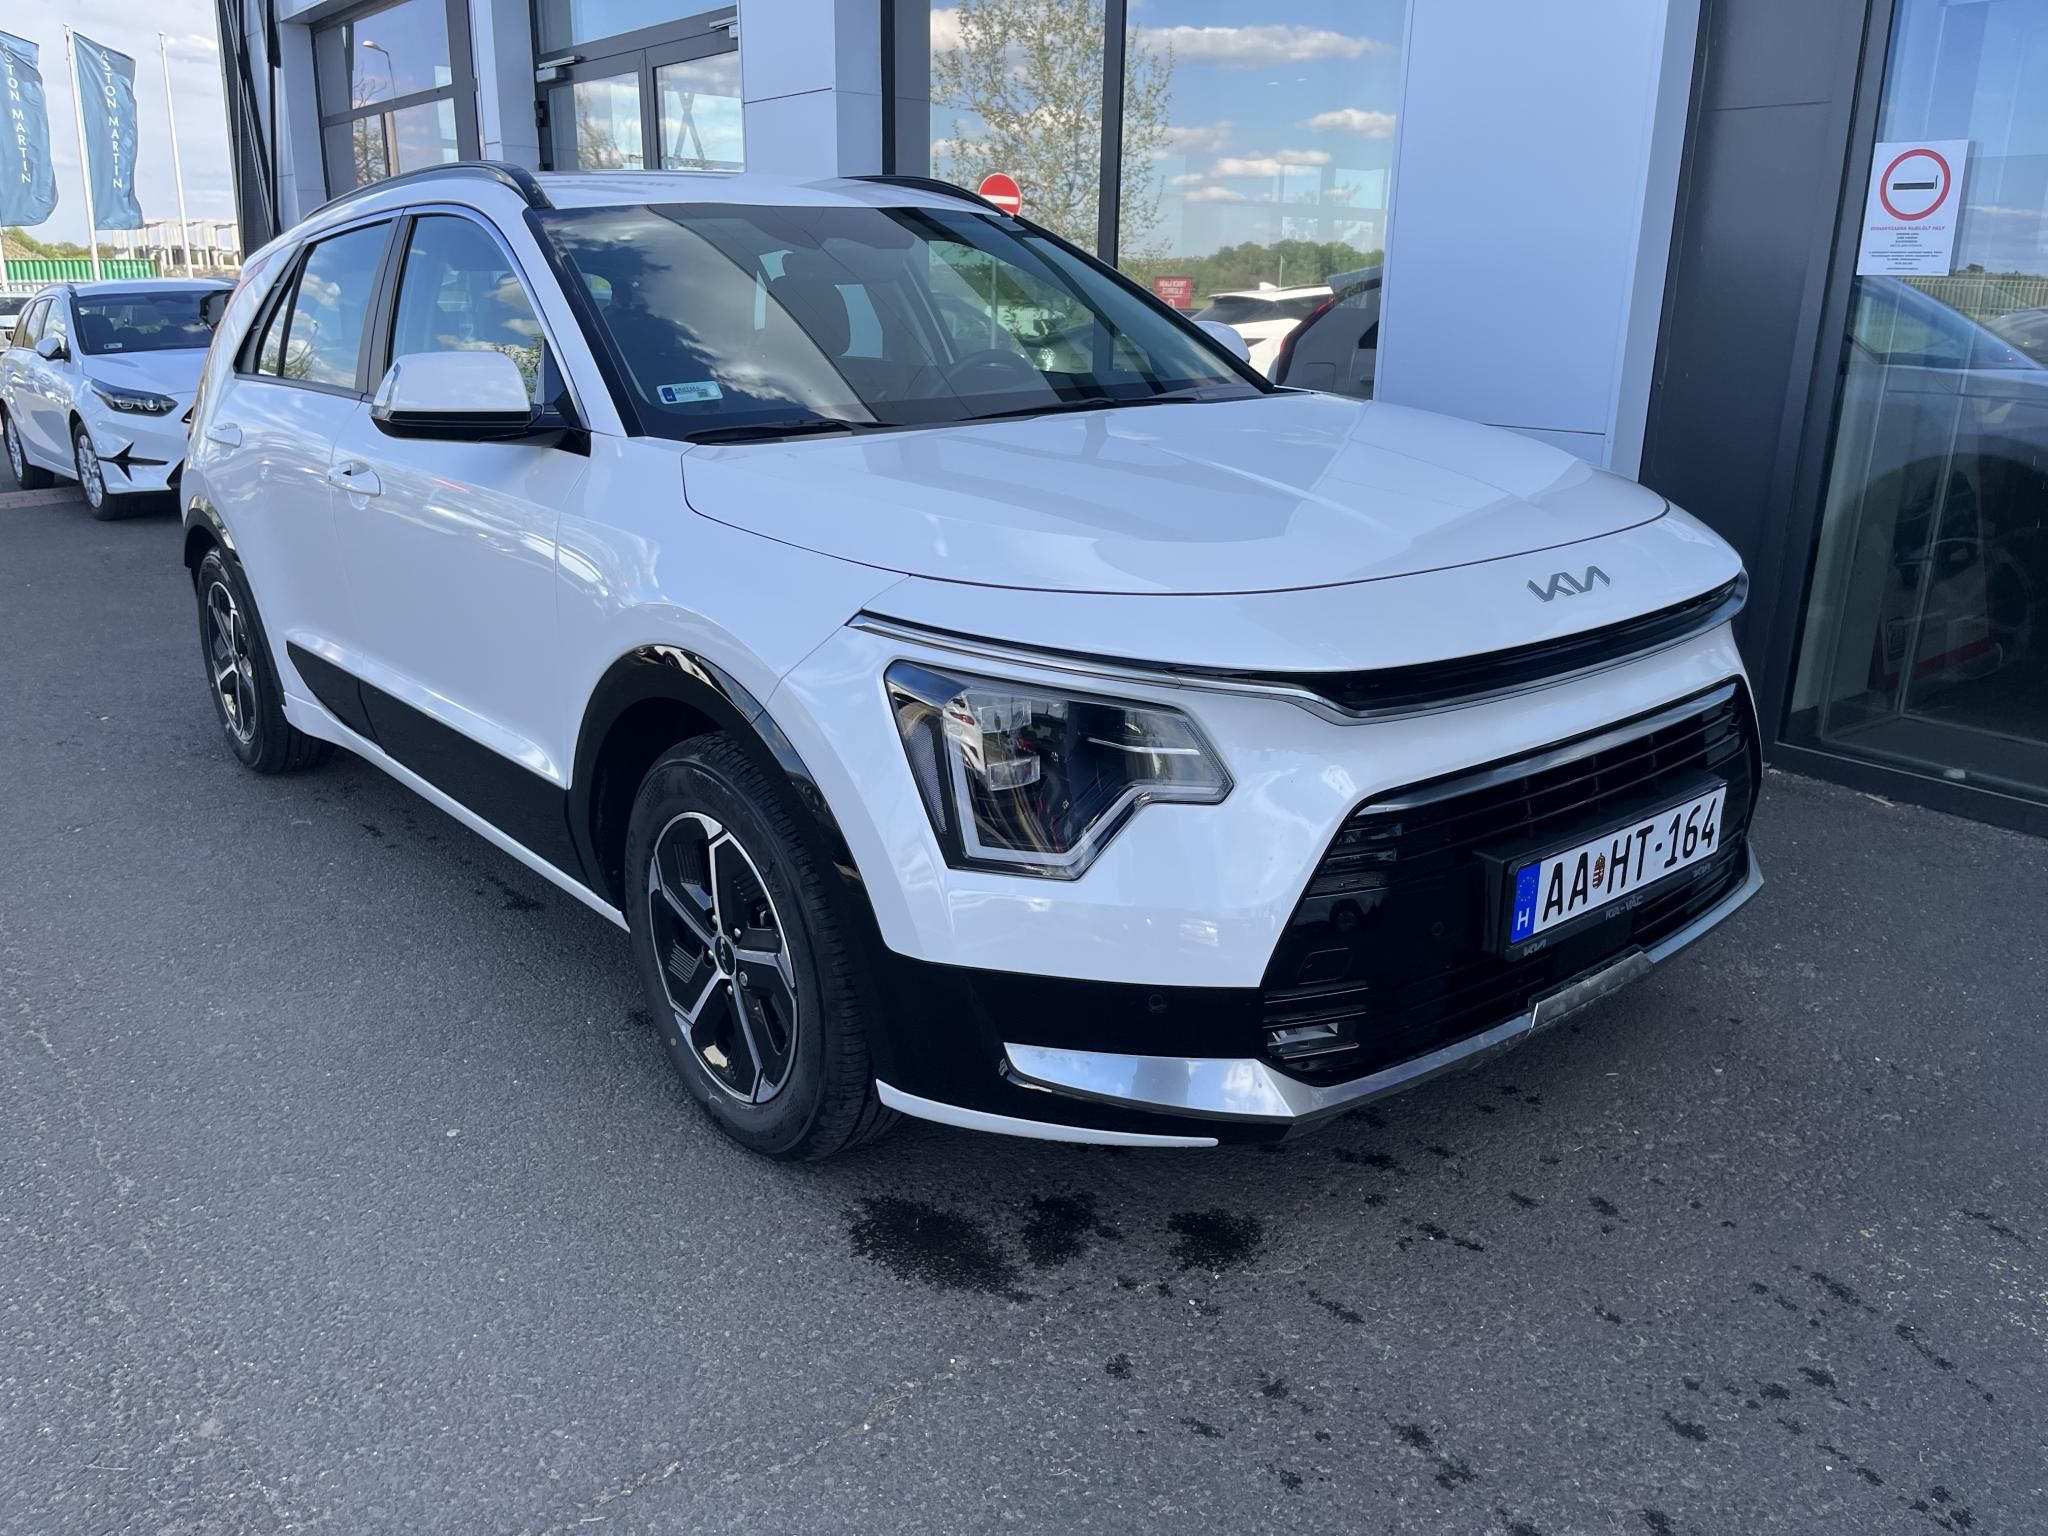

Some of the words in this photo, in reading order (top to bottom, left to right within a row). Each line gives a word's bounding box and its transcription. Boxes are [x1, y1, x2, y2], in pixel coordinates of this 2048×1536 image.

[12, 109, 32, 184] MARTIN
[99, 50, 117, 109] ASTON
[108, 116, 123, 190] MARTIN
[1526, 565, 1611, 603] KIA
[1516, 908, 1530, 931] H
[1543, 852, 1589, 923] AA
